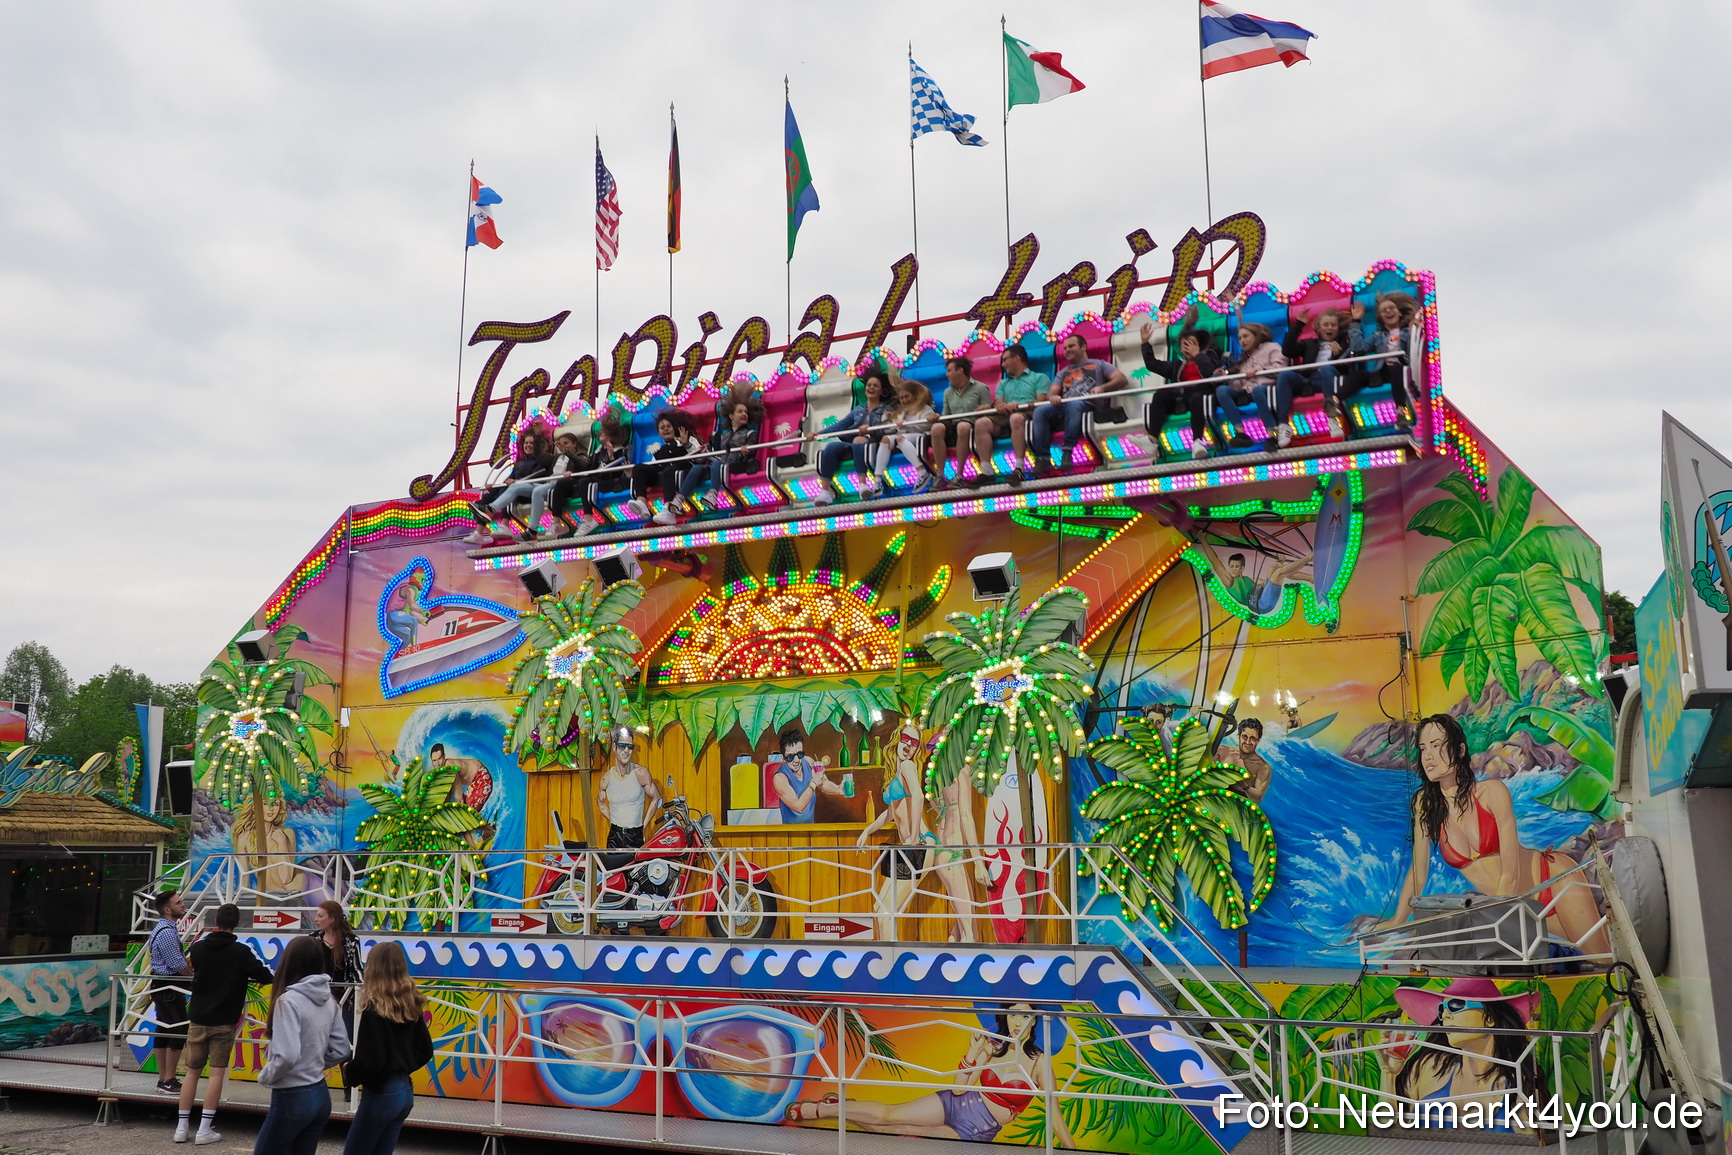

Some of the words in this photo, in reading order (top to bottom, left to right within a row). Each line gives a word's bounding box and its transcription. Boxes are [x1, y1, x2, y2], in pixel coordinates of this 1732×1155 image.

[409, 253, 919, 500] Tropical
[964, 211, 1267, 333] trip
[444, 620, 458, 636] 11
[259, 915, 282, 923] Eingang
[498, 918, 525, 927] Eingang
[813, 923, 846, 933] Eingang
